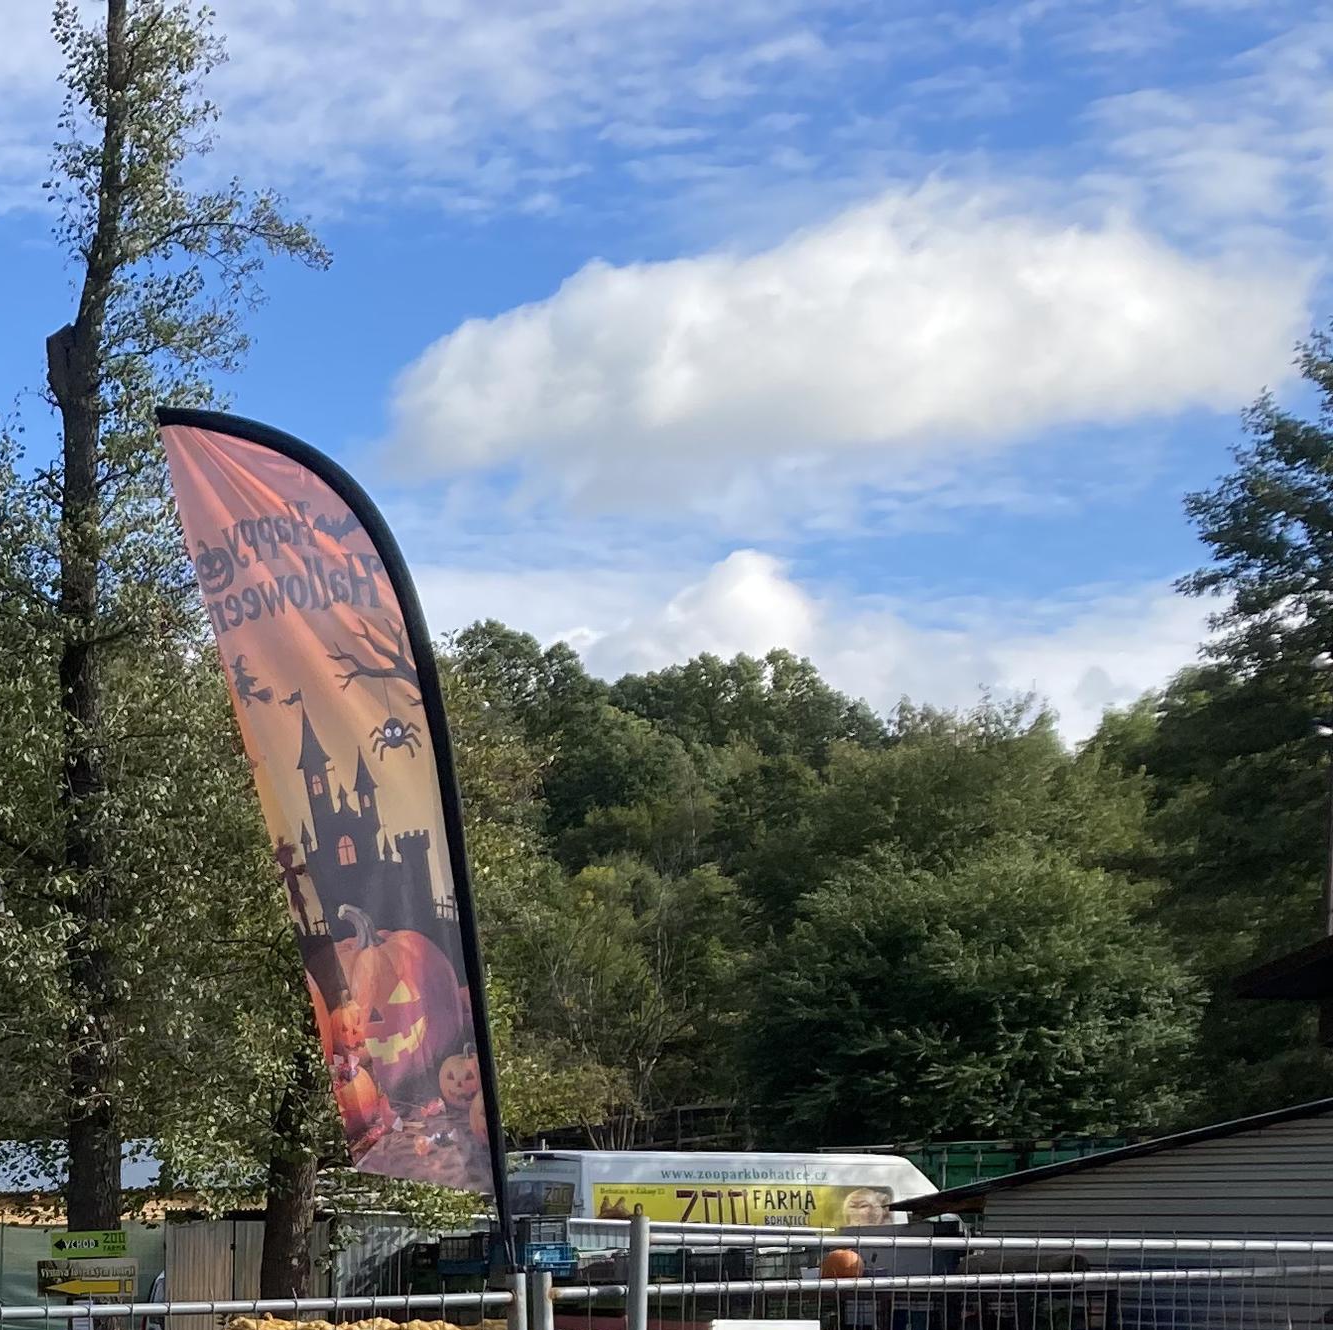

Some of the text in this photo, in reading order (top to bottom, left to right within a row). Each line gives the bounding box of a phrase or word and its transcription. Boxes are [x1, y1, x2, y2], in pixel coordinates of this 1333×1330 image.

[661, 1168, 828, 1182] www.zooparkbohatice.cz
[752, 1189, 817, 1210] FARMA
[64, 1239, 96, 1249] VCHOD
[102, 1232, 127, 1244] ZOO
